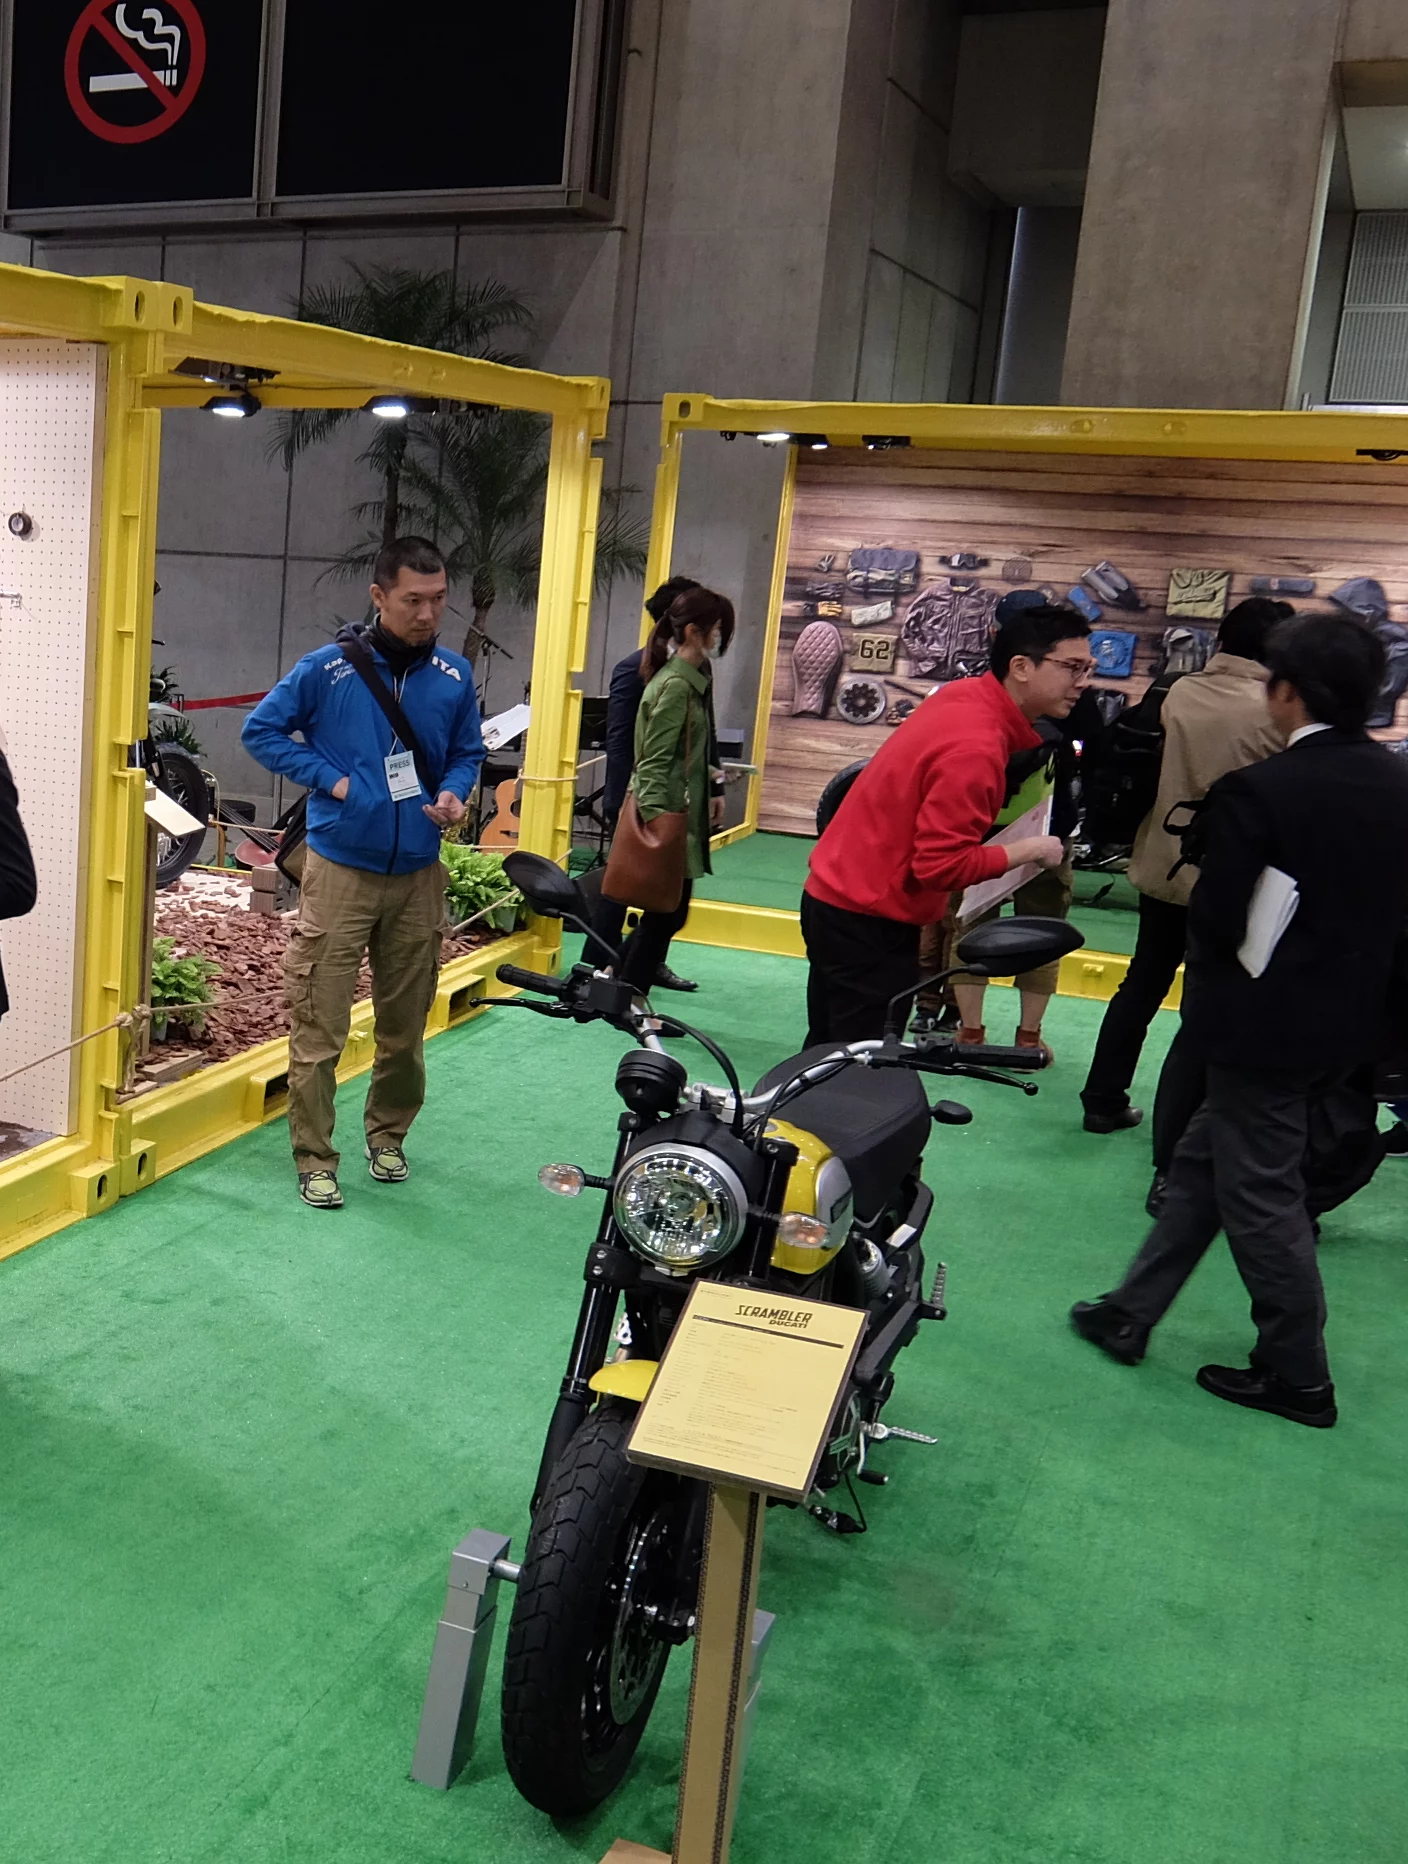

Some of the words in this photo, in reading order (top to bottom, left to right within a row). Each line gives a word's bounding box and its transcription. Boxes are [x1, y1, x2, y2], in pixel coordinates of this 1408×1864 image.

[860, 639, 890, 660] 62
[323, 657, 347, 671] Kap
[431, 655, 462, 682] ITA
[389, 759, 411, 769] PRESS
[735, 1304, 814, 1324] SCRAMBLER
[768, 1319, 809, 1330] DUCATI
